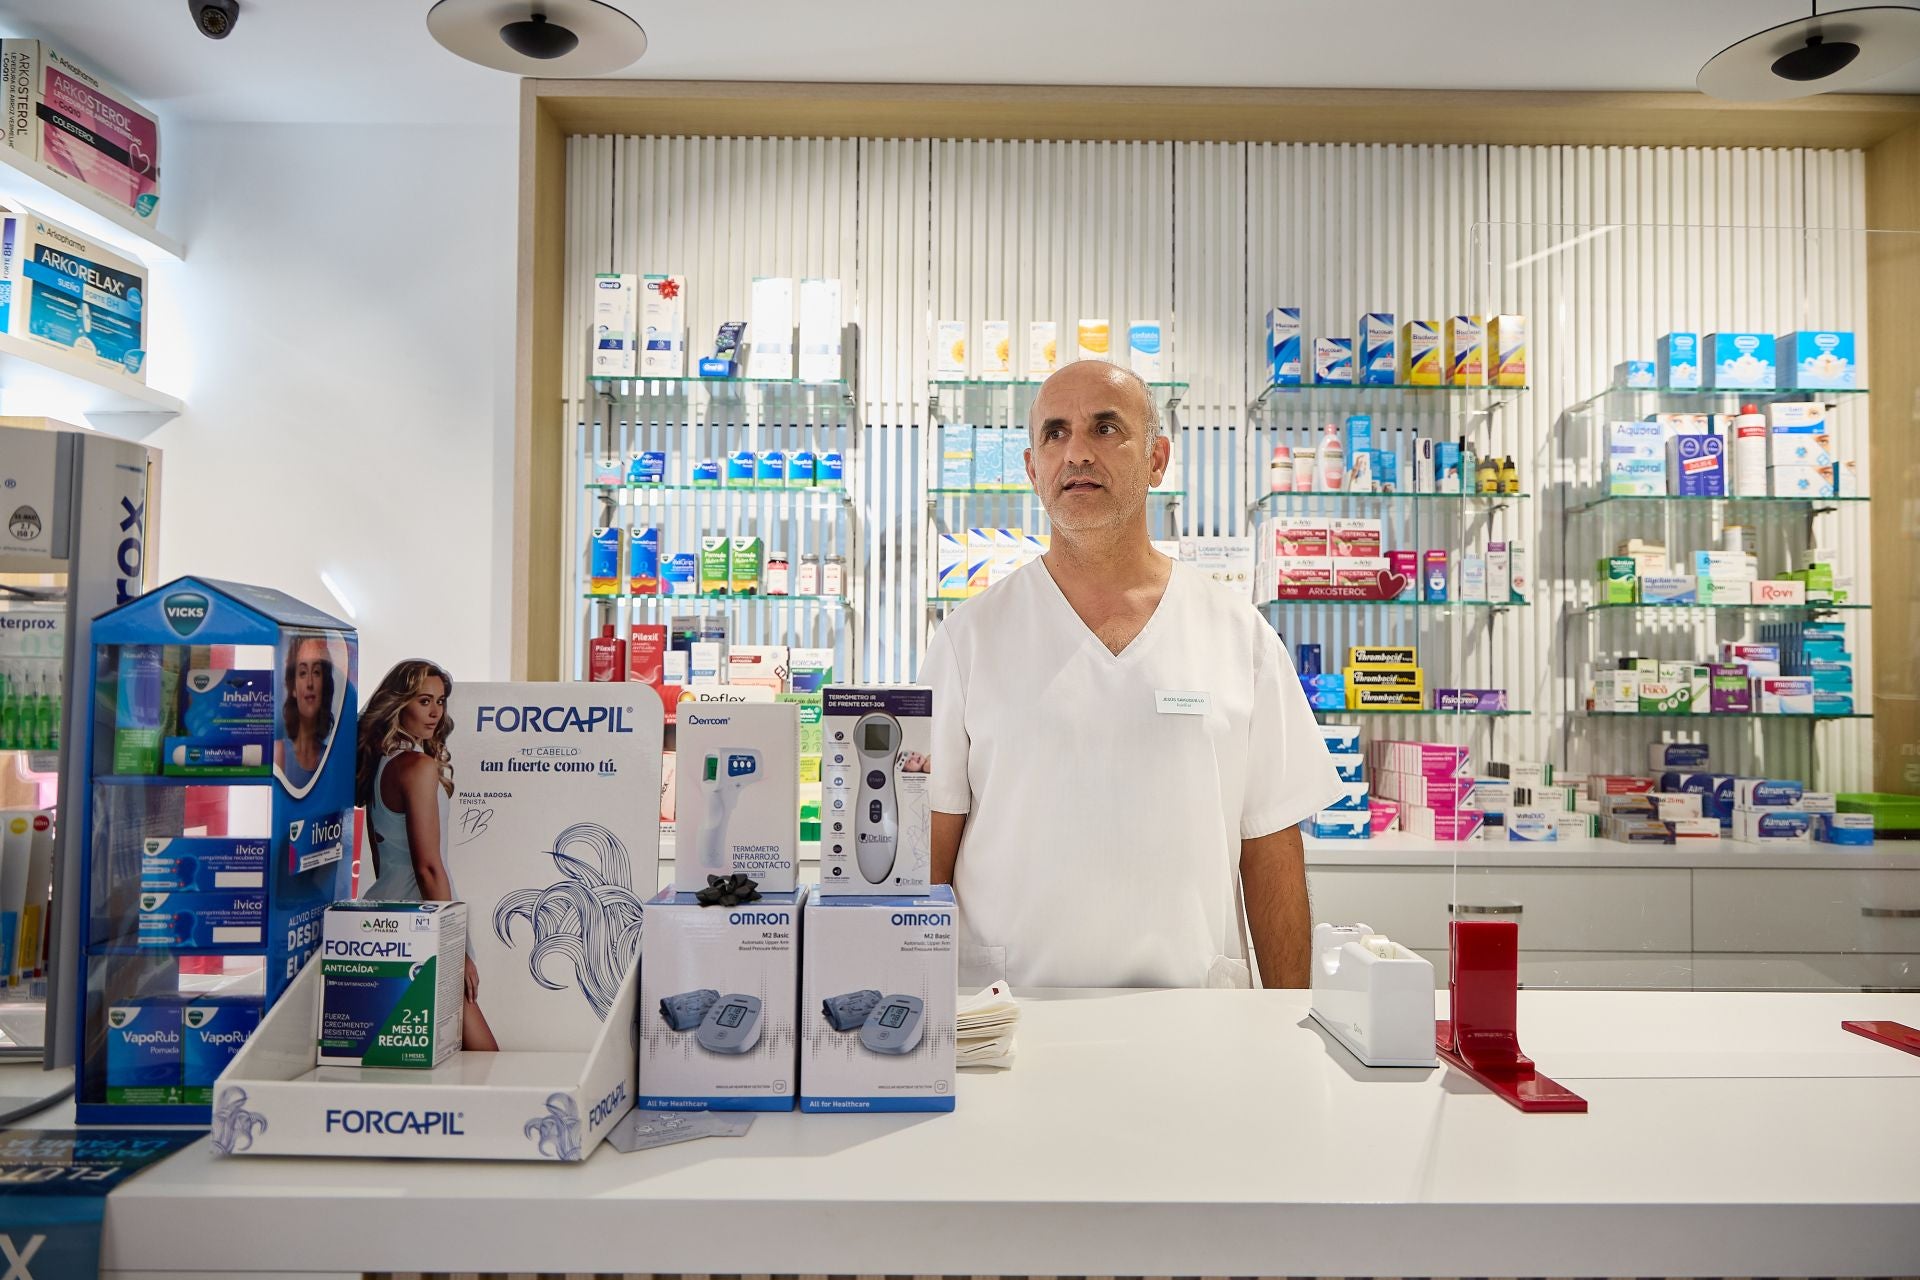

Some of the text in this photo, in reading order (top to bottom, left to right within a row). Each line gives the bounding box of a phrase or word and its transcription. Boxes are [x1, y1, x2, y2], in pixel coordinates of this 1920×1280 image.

[59, 57, 99, 88] Arkopharma
[17, 53, 30, 135] ARKOSTEROL
[53, 76, 132, 132] ARKOSTEROL
[52, 115, 95, 144] COLESTEROL
[47, 228, 86, 252] Arkopharma
[41, 250, 124, 296] ARKORELAX
[1308, 588, 1367, 596] ARKOSTEROL
[167, 607, 204, 618] VICKS
[0, 616, 56, 631] terprox
[632, 632, 659, 641] Pilexil
[223, 691, 274, 702] InhalVick
[476, 706, 633, 733] FORCAPIL
[521, 748, 578, 756] TU CABELLO
[480, 757, 617, 773] tan fuerte como tú.
[311, 822, 341, 845] ilvico
[236, 845, 264, 855] ilvico
[732, 844, 779, 852] TERMÓMETRO
[732, 853, 780, 861] INFRARROJO
[732, 861, 791, 869] SIN CONTACTO
[233, 900, 262, 910] ilvico
[288, 911, 309, 928] ALIVIO
[372, 918, 399, 930] Arko
[729, 913, 789, 925] OMRON
[891, 913, 951, 926] OMRON
[325, 940, 412, 957] FORCAPIL
[324, 963, 374, 973] ANTICAÍDA
[392, 1025, 428, 1034] MES DE
[122, 1030, 179, 1046] VapoRub
[378, 1035, 429, 1047] REGALO
[150, 1046, 179, 1054] Pomada
[588, 1082, 627, 1132] FORCAPIL
[325, 1109, 462, 1135] FORCAPIL
[0, 1166, 120, 1183] FLUT
